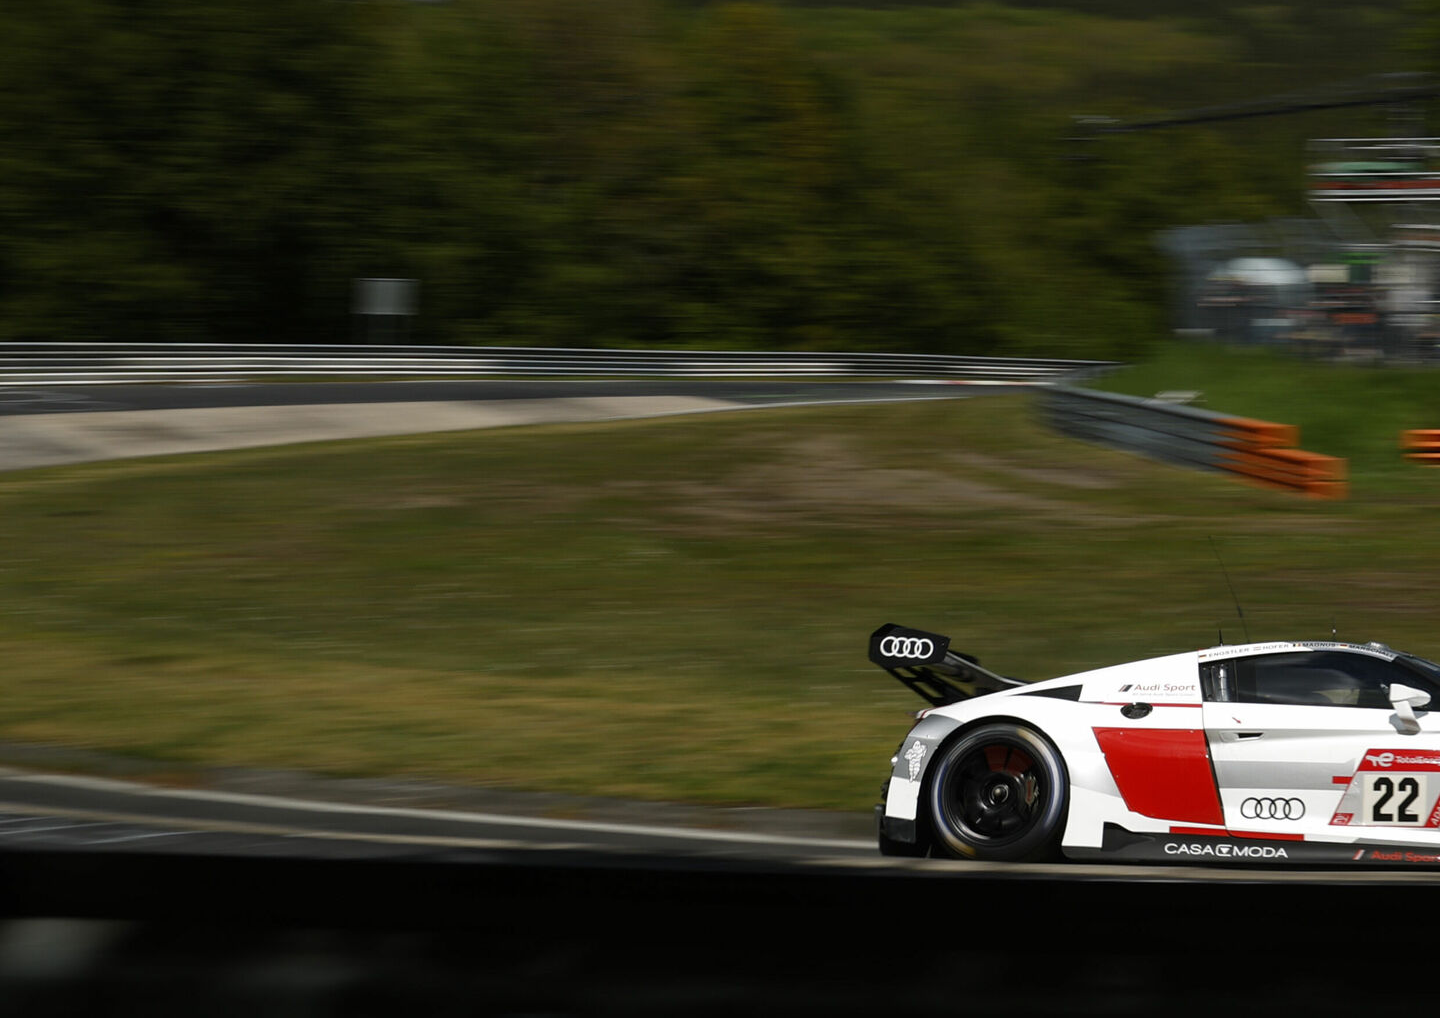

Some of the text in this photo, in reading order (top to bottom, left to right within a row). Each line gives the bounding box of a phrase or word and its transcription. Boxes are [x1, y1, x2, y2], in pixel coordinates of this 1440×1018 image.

[1163, 684, 1196, 693] Sport
[1372, 777, 1420, 823] 22
[1164, 843, 1289, 859] CASA MODA
[1370, 850, 1403, 861] Audi
